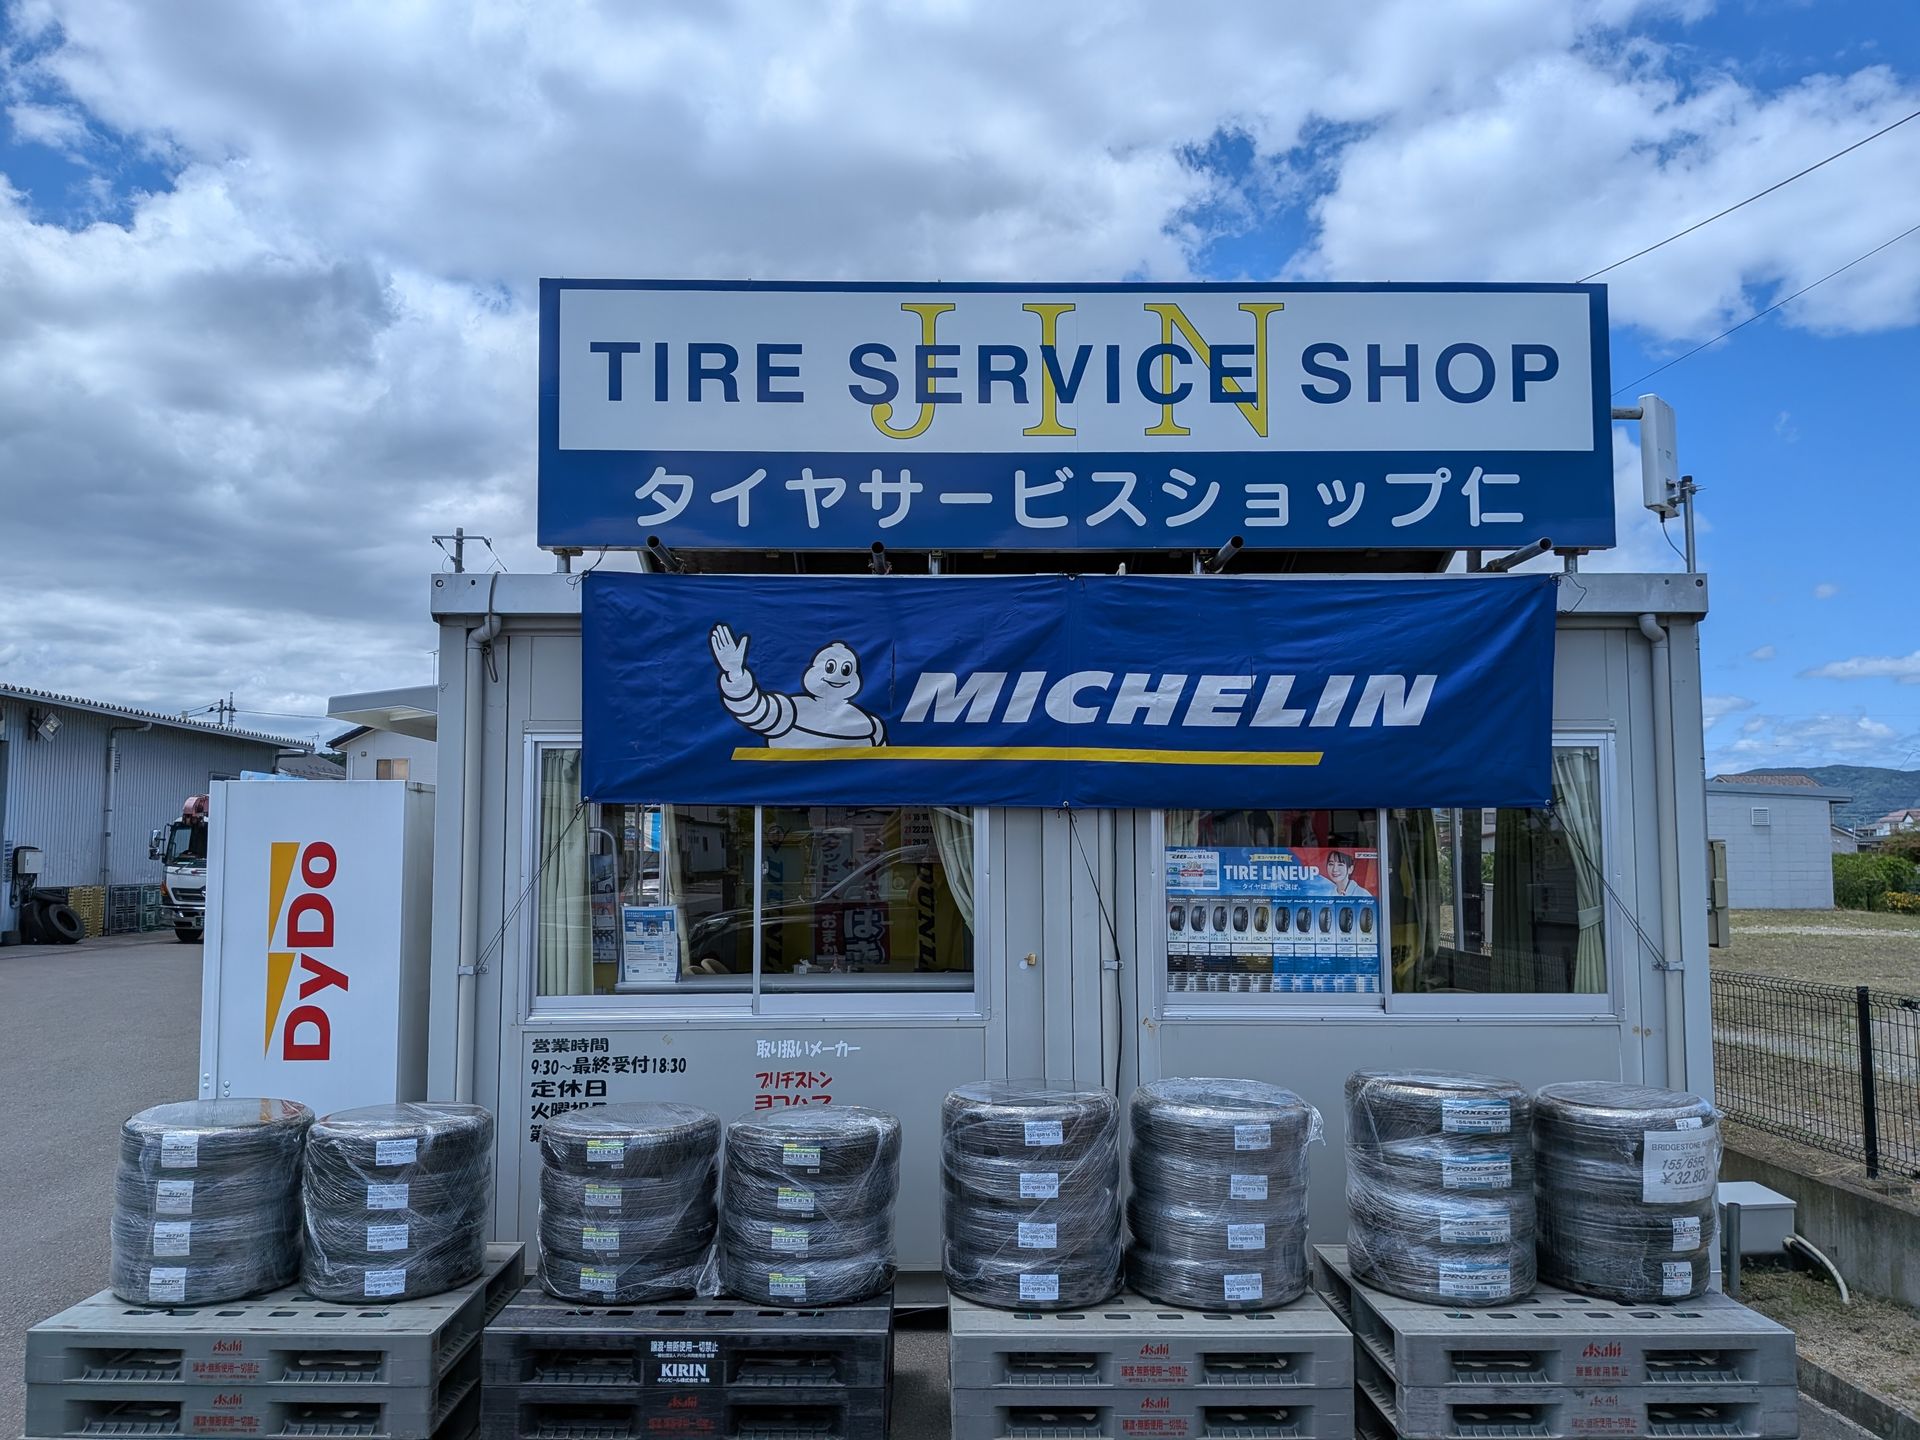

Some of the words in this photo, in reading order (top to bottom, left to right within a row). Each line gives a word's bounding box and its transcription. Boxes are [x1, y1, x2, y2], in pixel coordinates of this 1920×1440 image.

[589, 341, 804, 403] TIRE
[848, 342, 1258, 405] SERVICE
[1300, 342, 1560, 405] SHOP
[871, 302, 1284, 439] JIN
[635, 466, 1524, 529] タイヤサービスショップ仁
[900, 670, 1437, 728] MICHELIN
[1223, 865, 1258, 880] TIRE
[1262, 866, 1320, 881] LINEUP
[283, 841, 348, 1061] DyDo
[532, 1038, 609, 1053] 営業時間
[756, 1040, 861, 1058] 取り扱いメーカー
[756, 1071, 832, 1089] ブリヂストン
[531, 1079, 607, 1098] 定休日
[1652, 1142, 1700, 1151] BRIDGESTONE
[213, 1340, 242, 1352] Asahi
[650, 1341, 719, 1352] 譲渡・無断使用一切禁止
[1140, 1343, 1169, 1355] Asahi
[1582, 1342, 1622, 1357] Asahi
[661, 1364, 706, 1377] KIRIN
[213, 1394, 242, 1406] Asahi
[1141, 1396, 1169, 1408] Asahi
